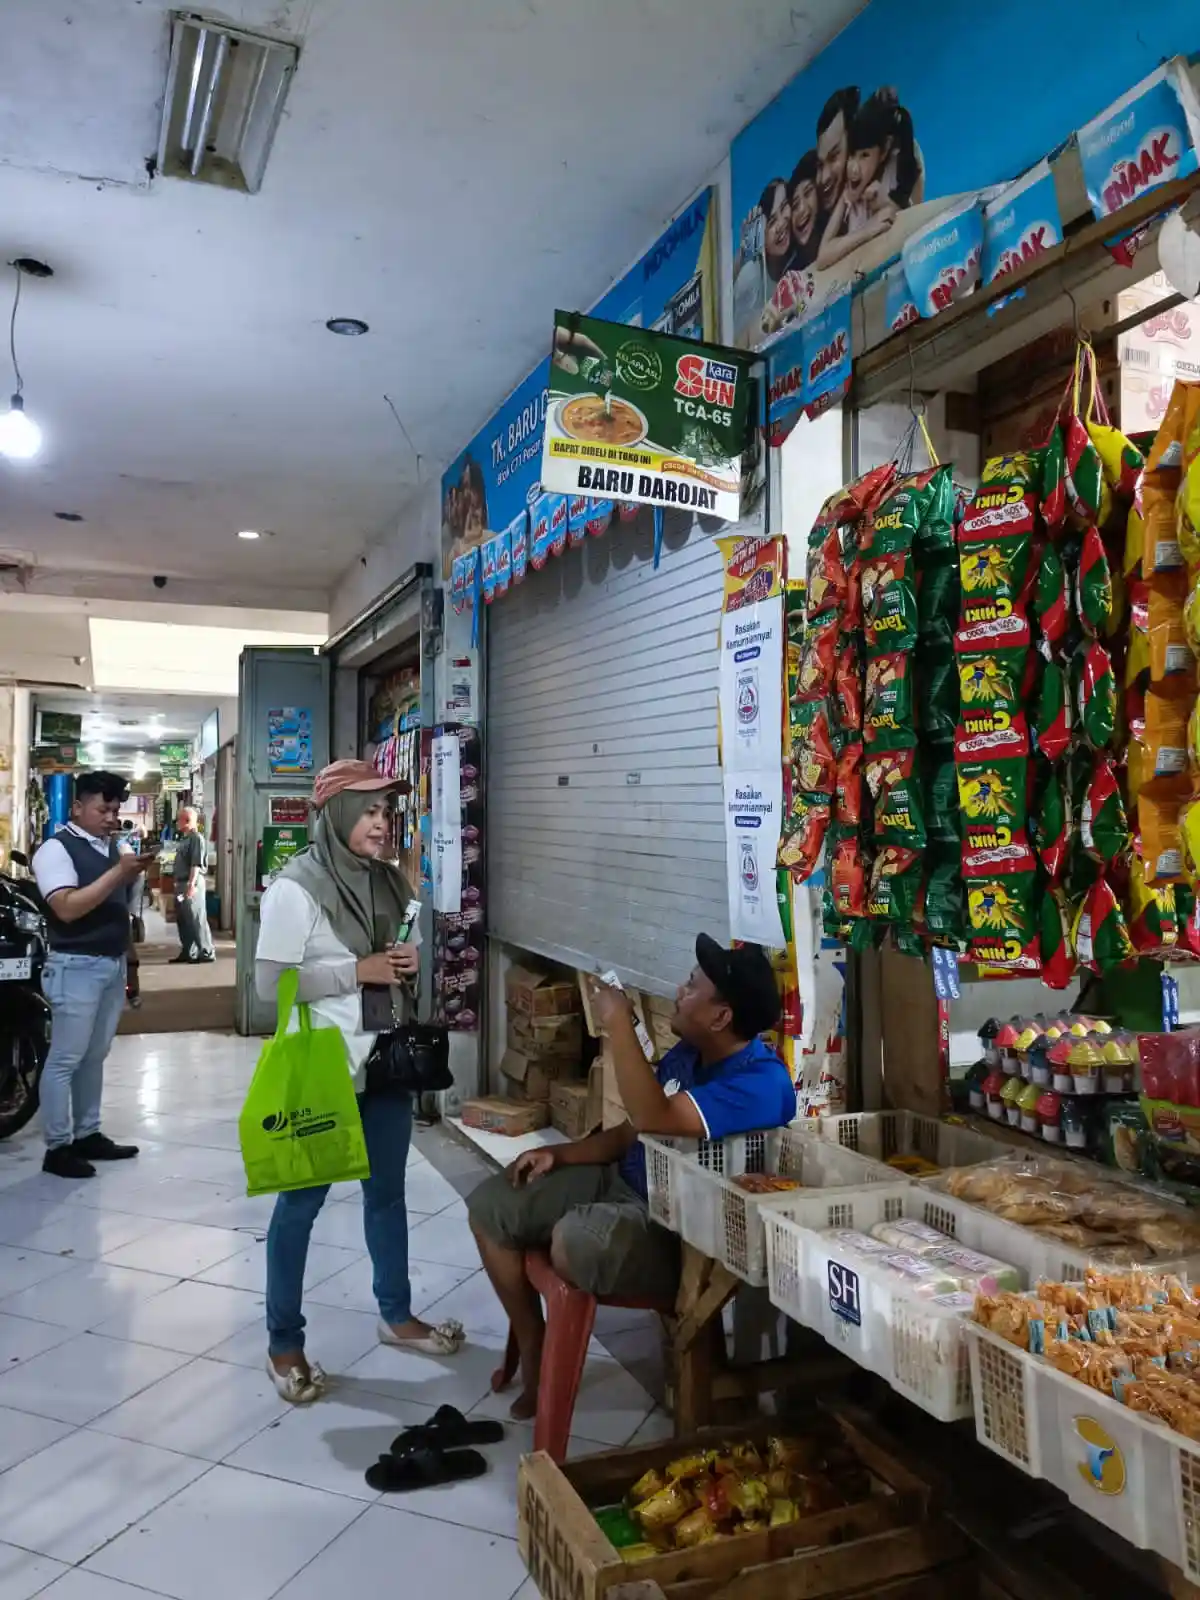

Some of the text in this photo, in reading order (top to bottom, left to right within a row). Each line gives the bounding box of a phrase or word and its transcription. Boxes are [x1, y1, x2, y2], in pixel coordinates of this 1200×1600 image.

[1102, 132, 1170, 213] ENAAK
[674, 354, 736, 409] SUN
[708, 363, 733, 380] kara
[674, 398, 732, 427] TCA-65
[508, 397, 538, 453] BARU
[554, 443, 652, 464] DAPAT DIBELI DI TOKO INI
[577, 465, 634, 495] BARU
[638, 475, 719, 510] DAROJAT
[976, 485, 1025, 509] CHIKI
[875, 512, 904, 529] Taro
[965, 597, 1012, 624] CHIKI
[873, 613, 907, 632] Taro
[871, 713, 902, 729] Taro
[965, 711, 1011, 734] CHIKI
[882, 813, 916, 830] Taro
[968, 827, 1012, 849] CHIKI
[829, 1263, 858, 1310] SH
